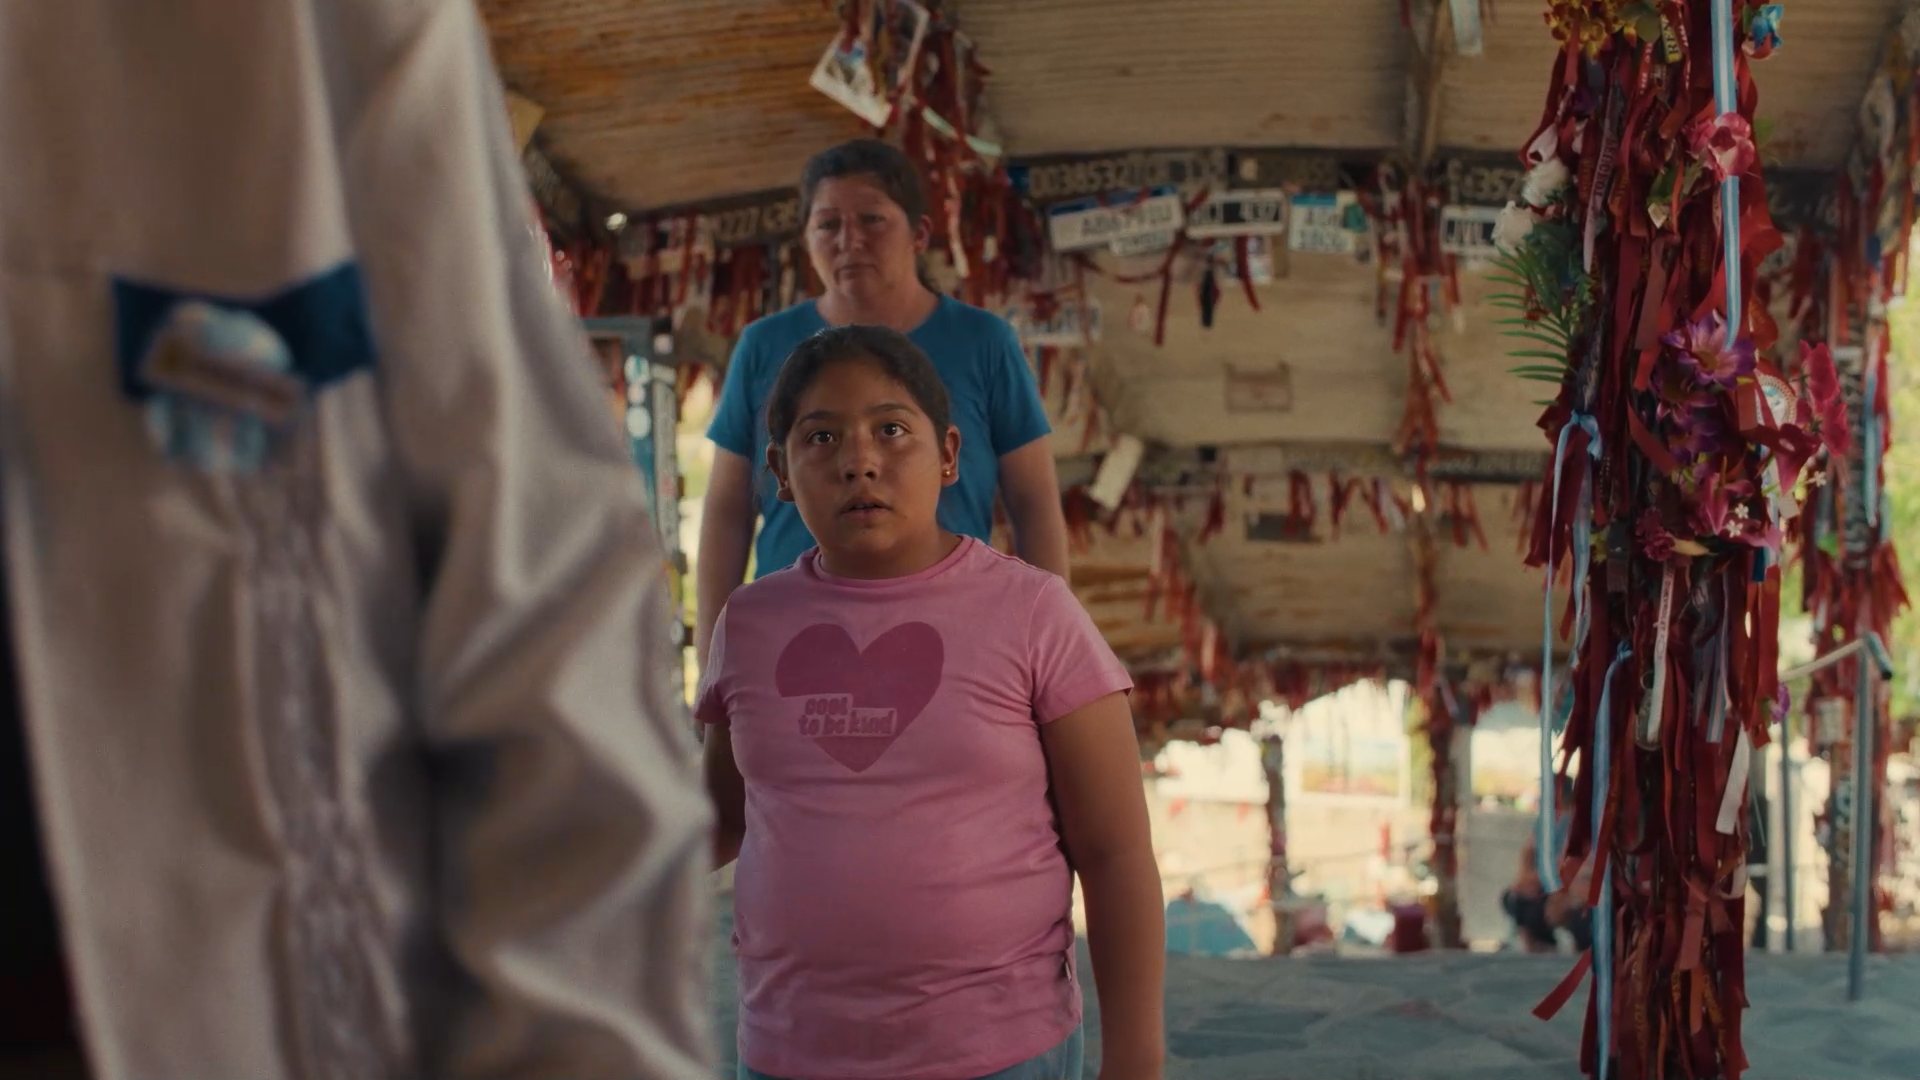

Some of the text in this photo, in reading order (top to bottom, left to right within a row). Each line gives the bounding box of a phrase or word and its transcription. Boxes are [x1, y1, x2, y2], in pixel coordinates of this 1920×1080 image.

[798, 709, 895, 737] to be kind
